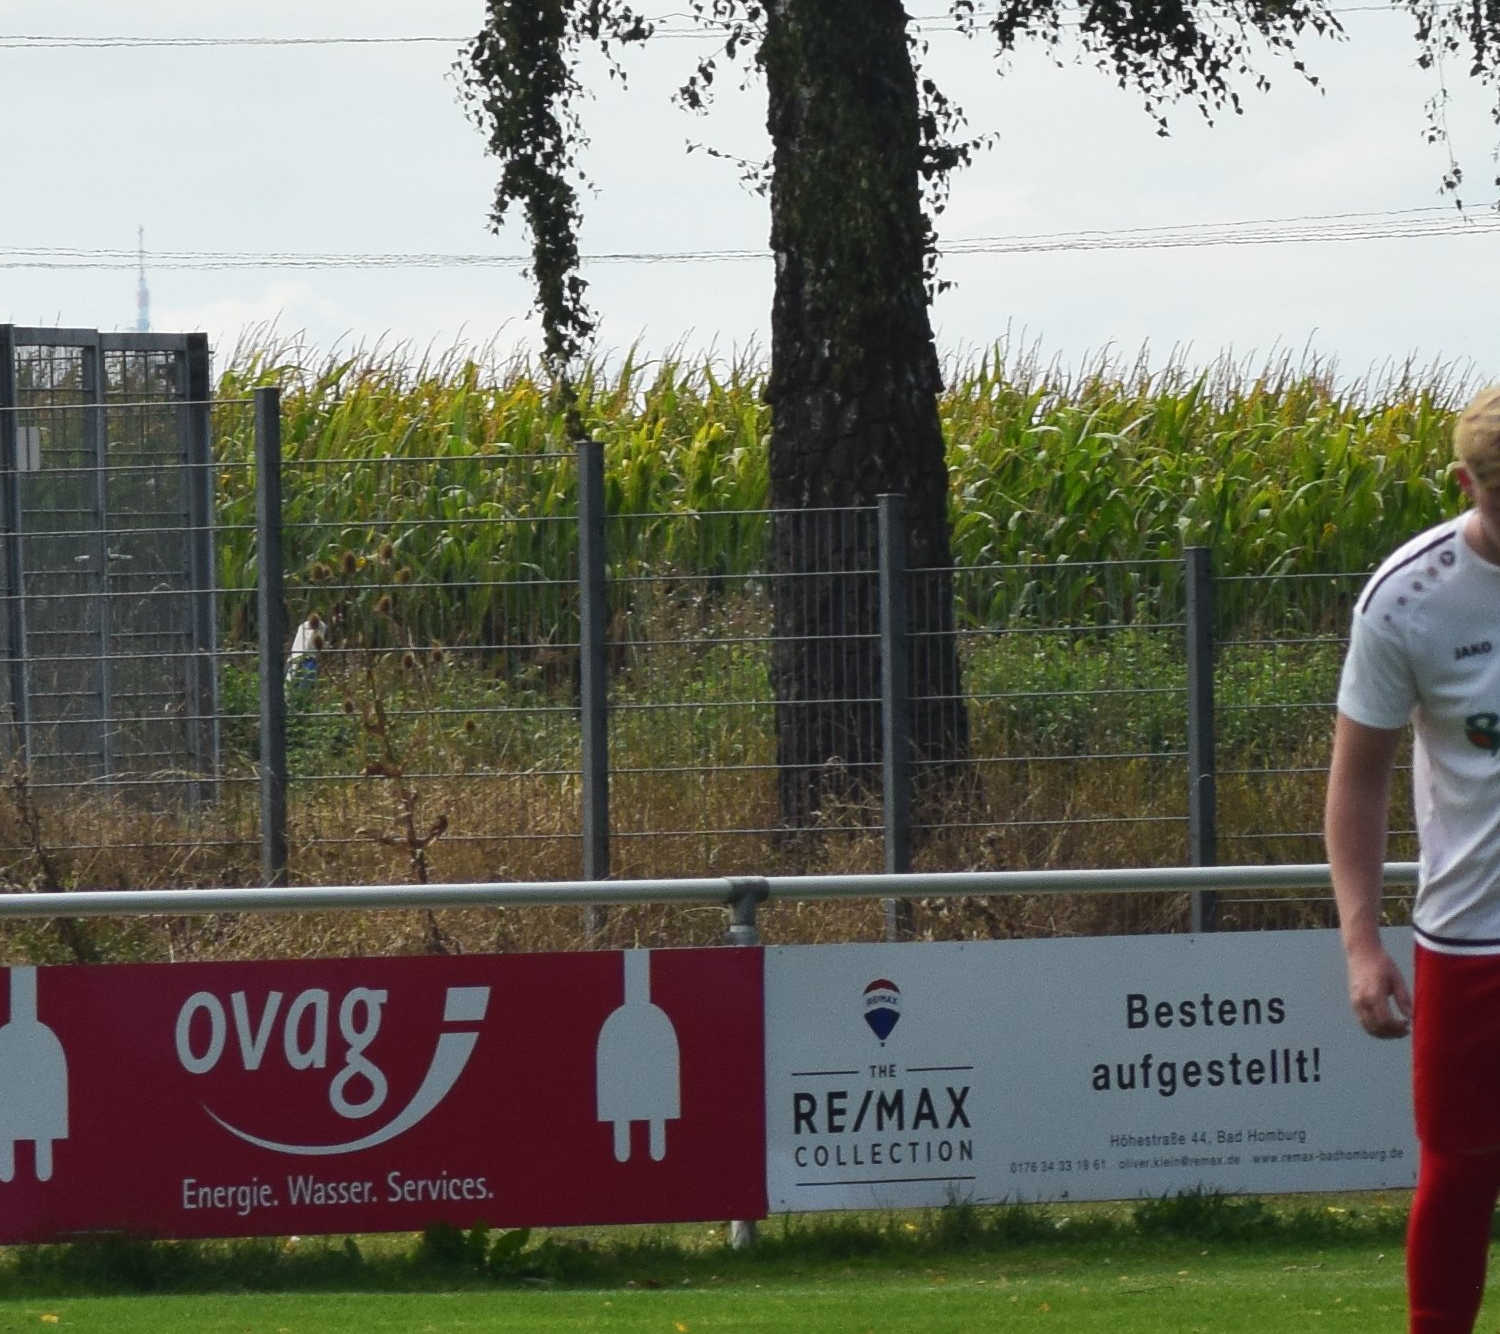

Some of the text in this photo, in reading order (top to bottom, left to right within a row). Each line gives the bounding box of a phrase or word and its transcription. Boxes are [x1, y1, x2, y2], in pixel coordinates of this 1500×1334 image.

[1454, 640, 1493, 660] JAKO
[1126, 992, 1286, 1029] Bestens
[173, 984, 390, 1120] ovag
[869, 1064, 897, 1079] THE
[1091, 1047, 1321, 1097] aufgestellt!
[793, 1085, 972, 1135] RE/MAX
[794, 1139, 974, 1168] COLLECTION
[1110, 1132, 1186, 1148] Höhestraße
[1216, 1130, 1243, 1144] Bad
[1247, 1128, 1307, 1145] Homburg
[181, 1169, 495, 1215] Energie. Wasser. Services.
